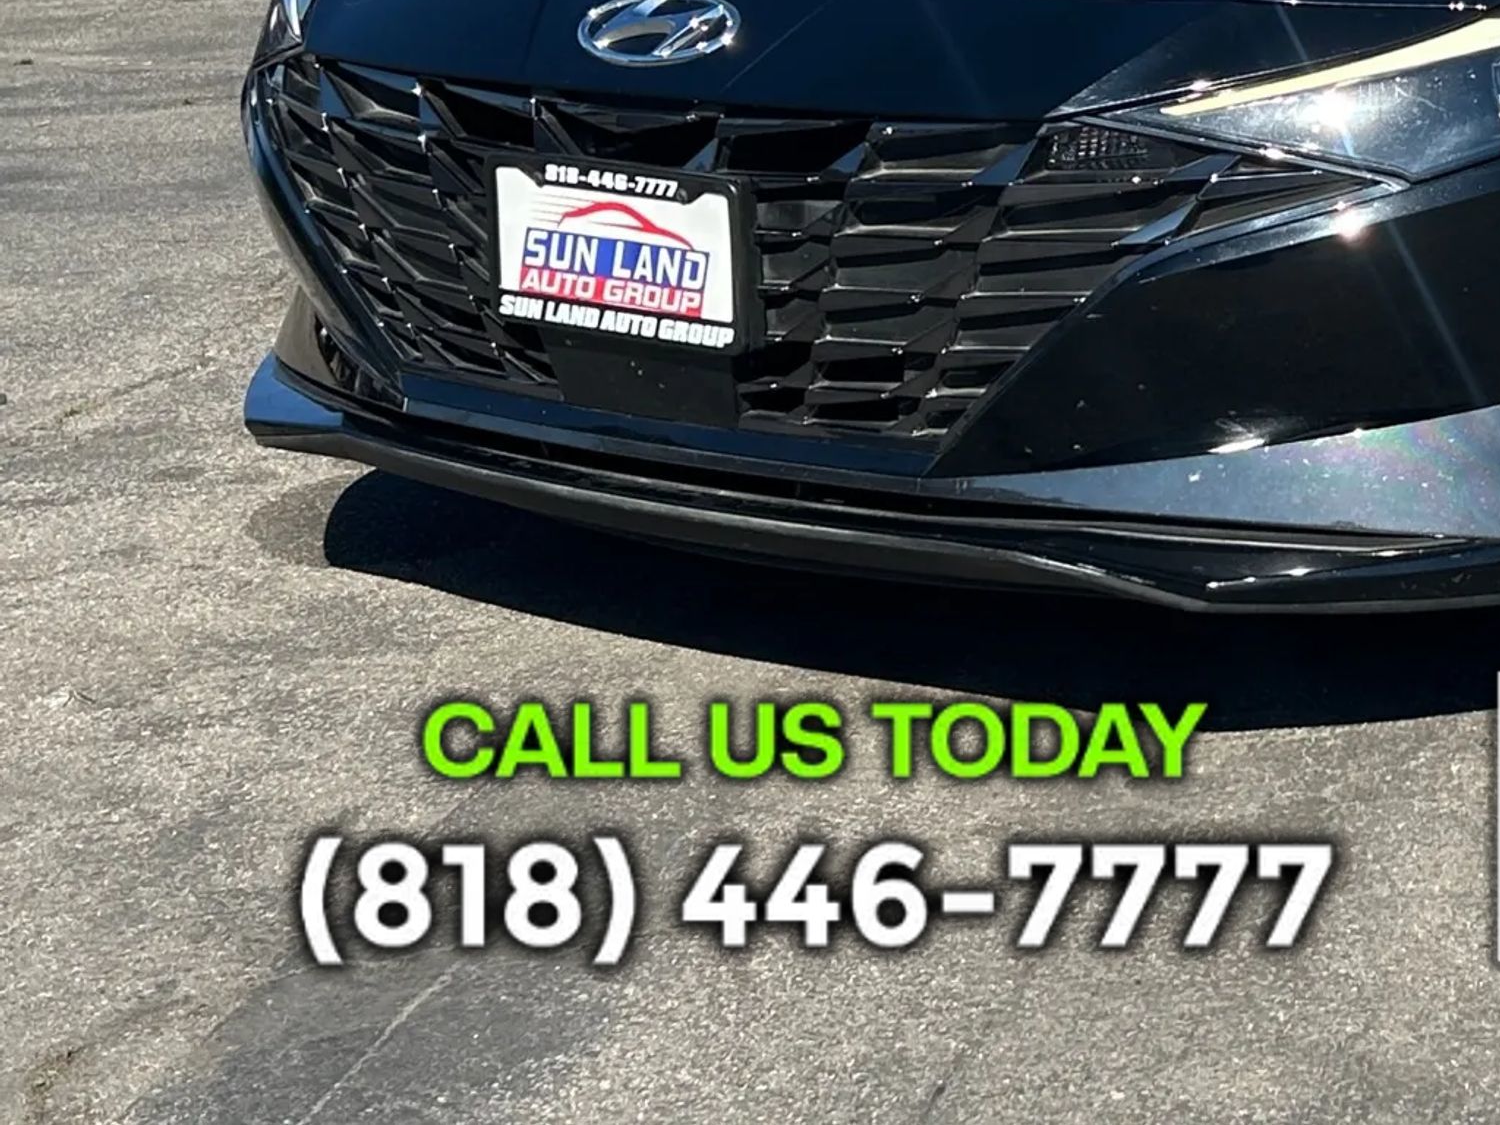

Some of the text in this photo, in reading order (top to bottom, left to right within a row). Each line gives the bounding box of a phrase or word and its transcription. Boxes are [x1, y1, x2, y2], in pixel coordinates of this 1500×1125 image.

[544, 163, 679, 199] 818-446-7777
[524, 229, 707, 292] SUN LAND
[521, 269, 702, 315] AUTO GROUP
[499, 294, 736, 349] SUN LAND AUTO GROUP
